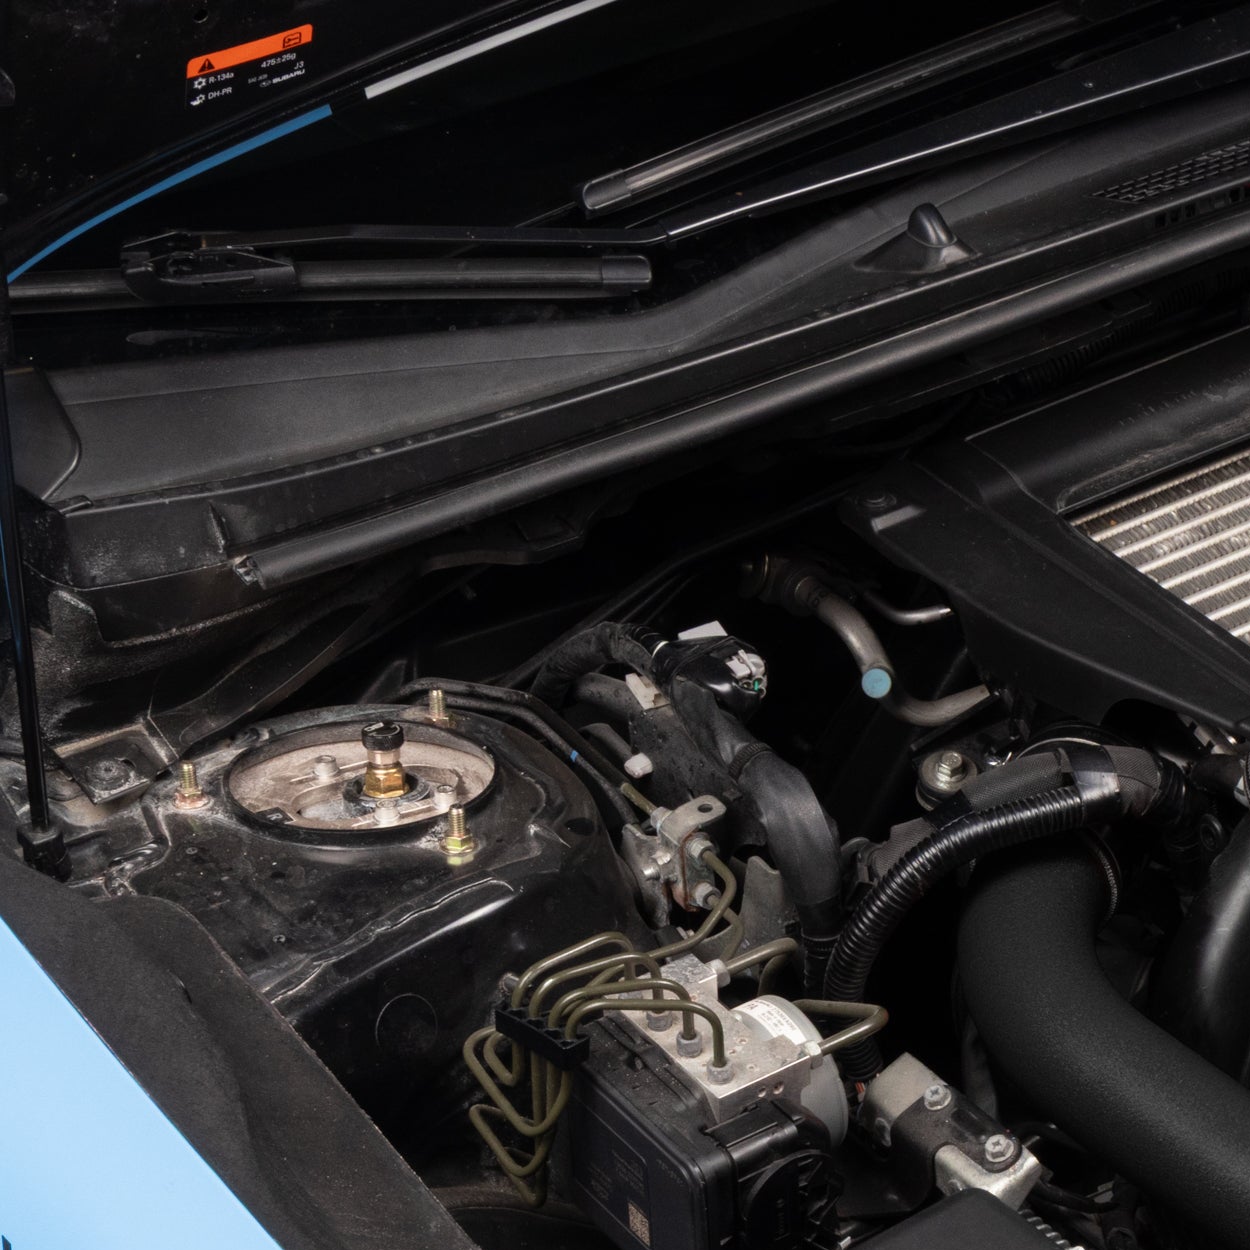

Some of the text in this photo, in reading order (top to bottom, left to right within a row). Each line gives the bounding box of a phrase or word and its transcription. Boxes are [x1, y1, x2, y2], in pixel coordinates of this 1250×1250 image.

[208, 72, 235, 84] R-134a
[272, 69, 305, 84] SUBARU
[207, 87, 233, 100] DH-PR
